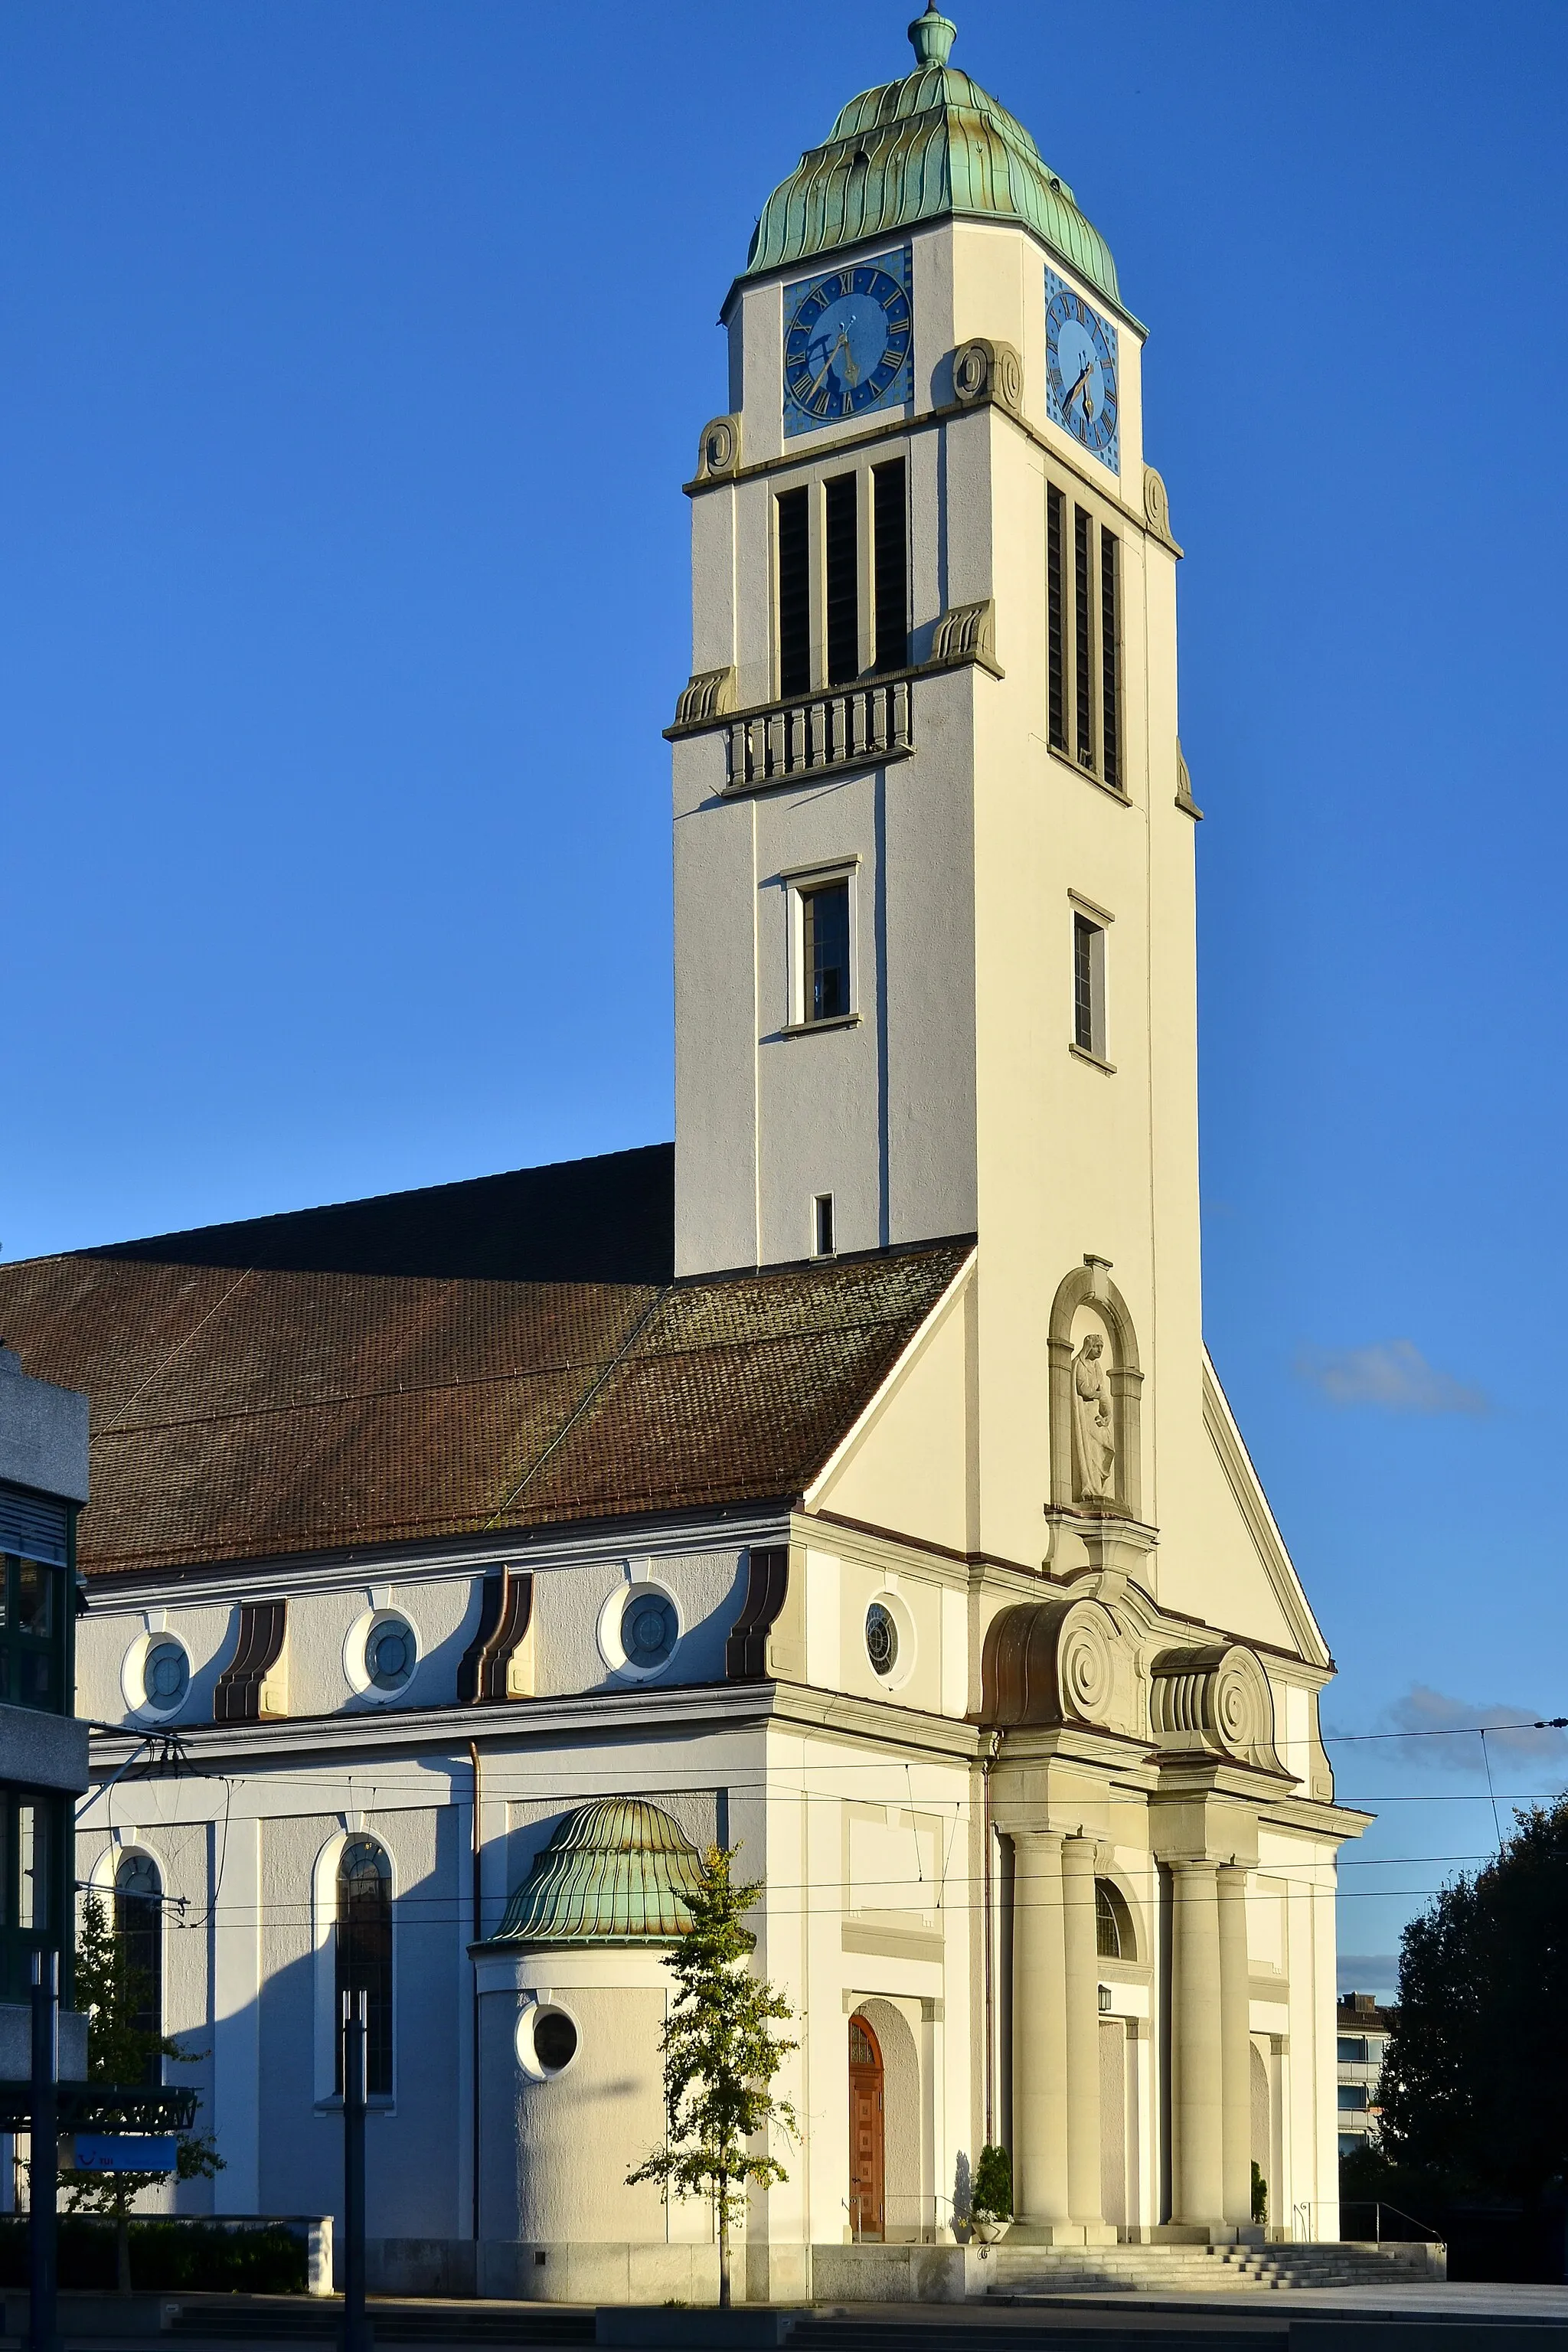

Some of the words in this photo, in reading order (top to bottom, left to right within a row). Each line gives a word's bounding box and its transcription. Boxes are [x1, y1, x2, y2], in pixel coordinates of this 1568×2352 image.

[838, 270, 855, 296] XII
[867, 271, 879, 294] I
[812, 289, 831, 310] XI
[882, 288, 902, 309] II
[1060, 296, 1071, 319] XI
[1075, 299, 1084, 325] XII
[792, 318, 812, 335] X
[890, 316, 910, 335] III
[1092, 325, 1100, 341] I
[787, 350, 805, 368] IX
[881, 349, 903, 369] IIII
[792, 373, 813, 400] VIII
[868, 378, 882, 397] V
[812, 391, 831, 415] VII
[841, 391, 854, 414] VI
[100, 2157, 113, 2165] TUI
